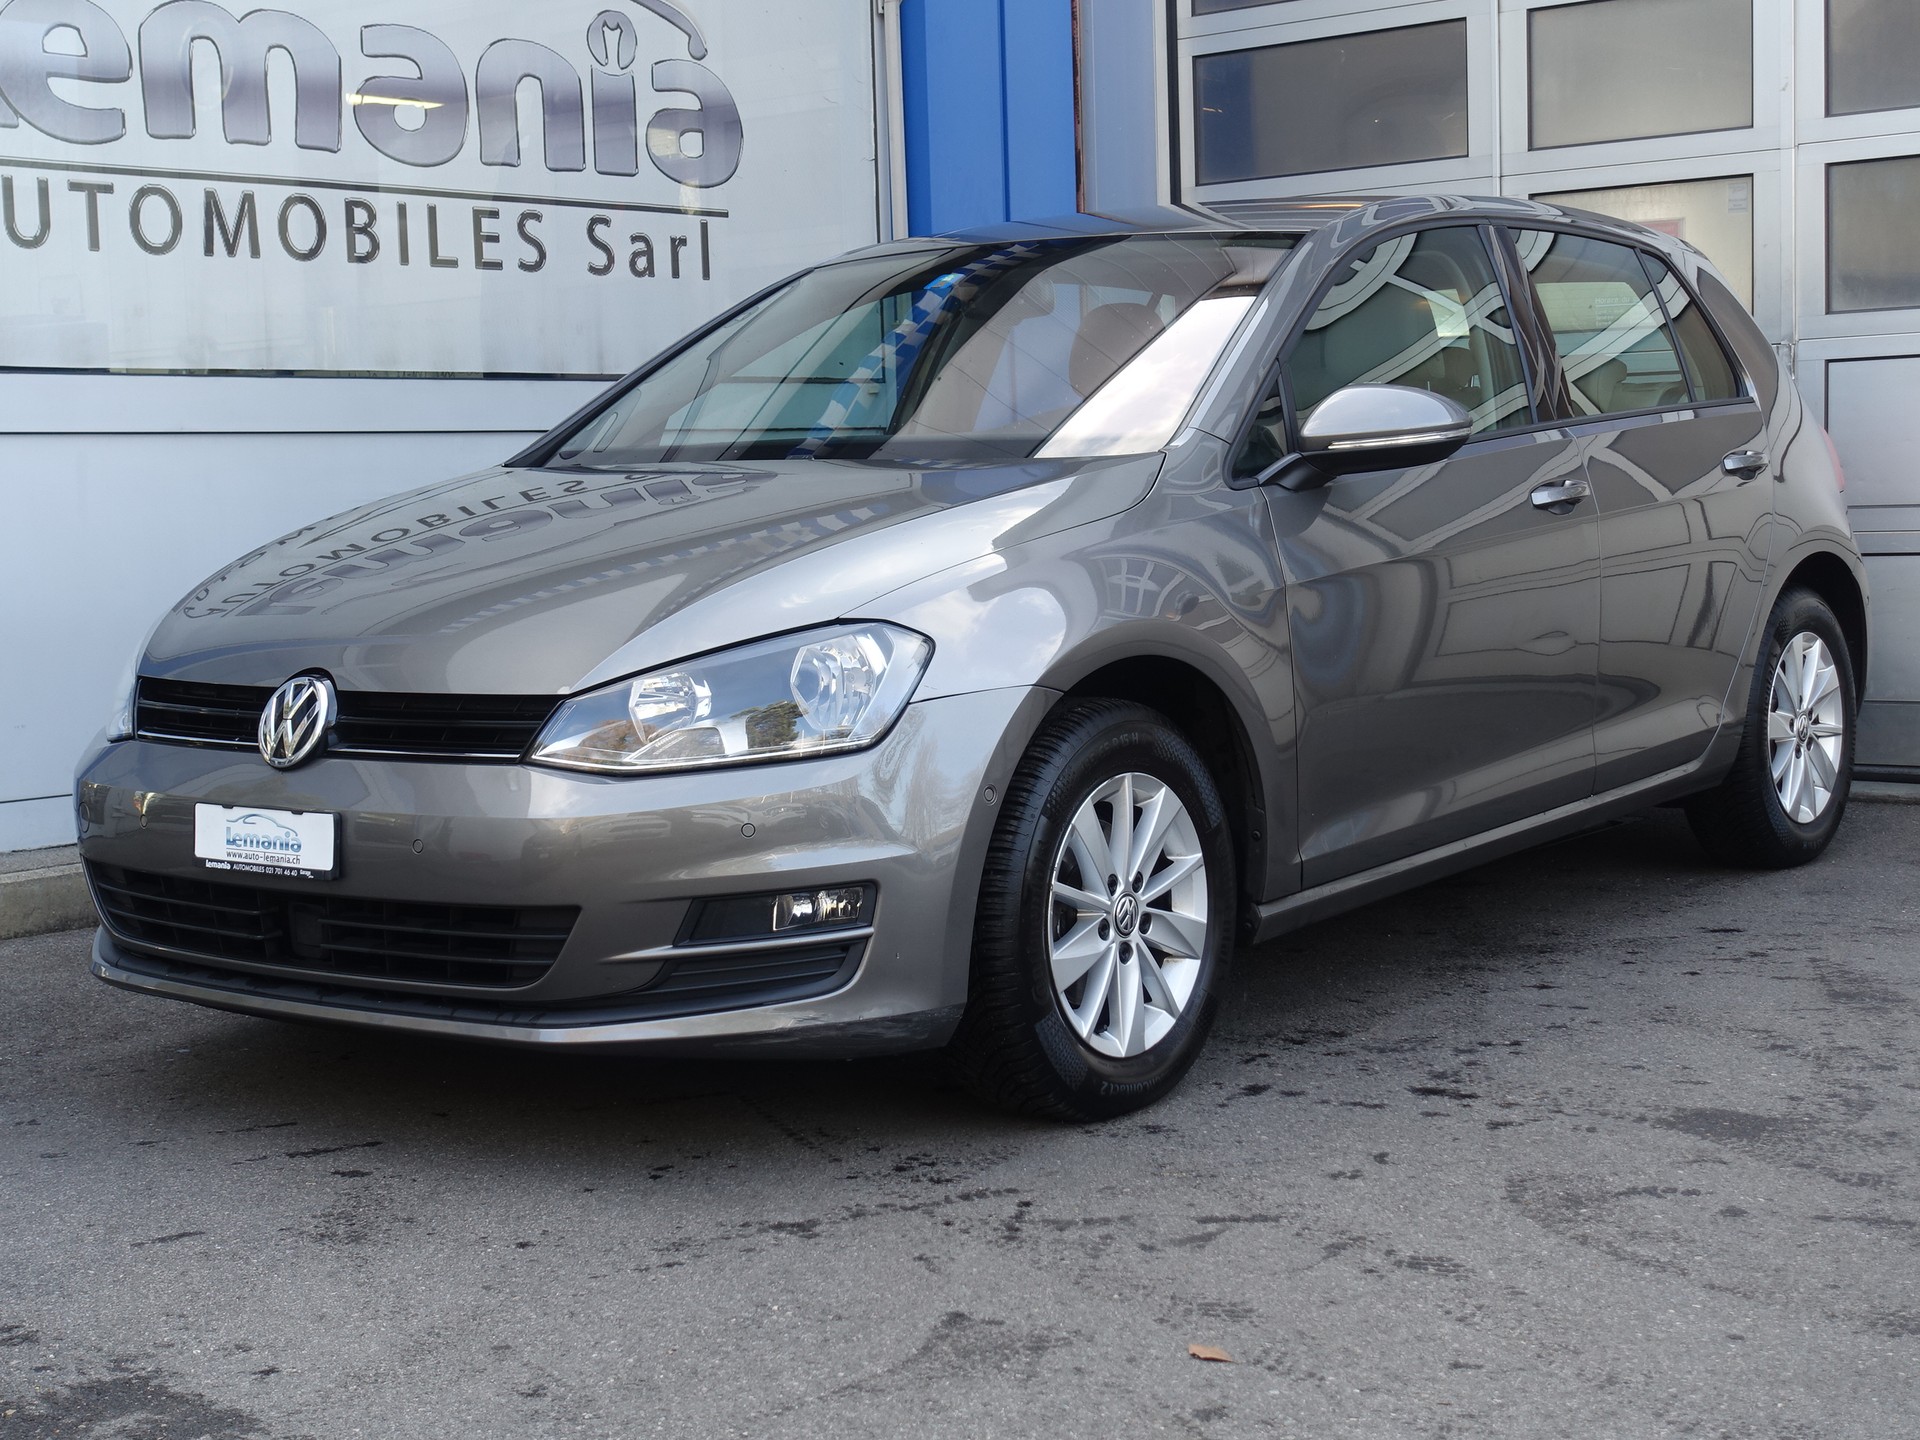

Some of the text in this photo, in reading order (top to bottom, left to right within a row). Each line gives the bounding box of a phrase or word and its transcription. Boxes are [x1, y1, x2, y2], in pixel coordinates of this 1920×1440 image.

[0, 0, 744, 189] emania
[587, 214, 711, 281] Sarl
[258, 676, 328, 768] VW
[226, 850, 301, 865] www.auto-lemania.ch
[233, 864, 265, 874] AUTOMOBILES
